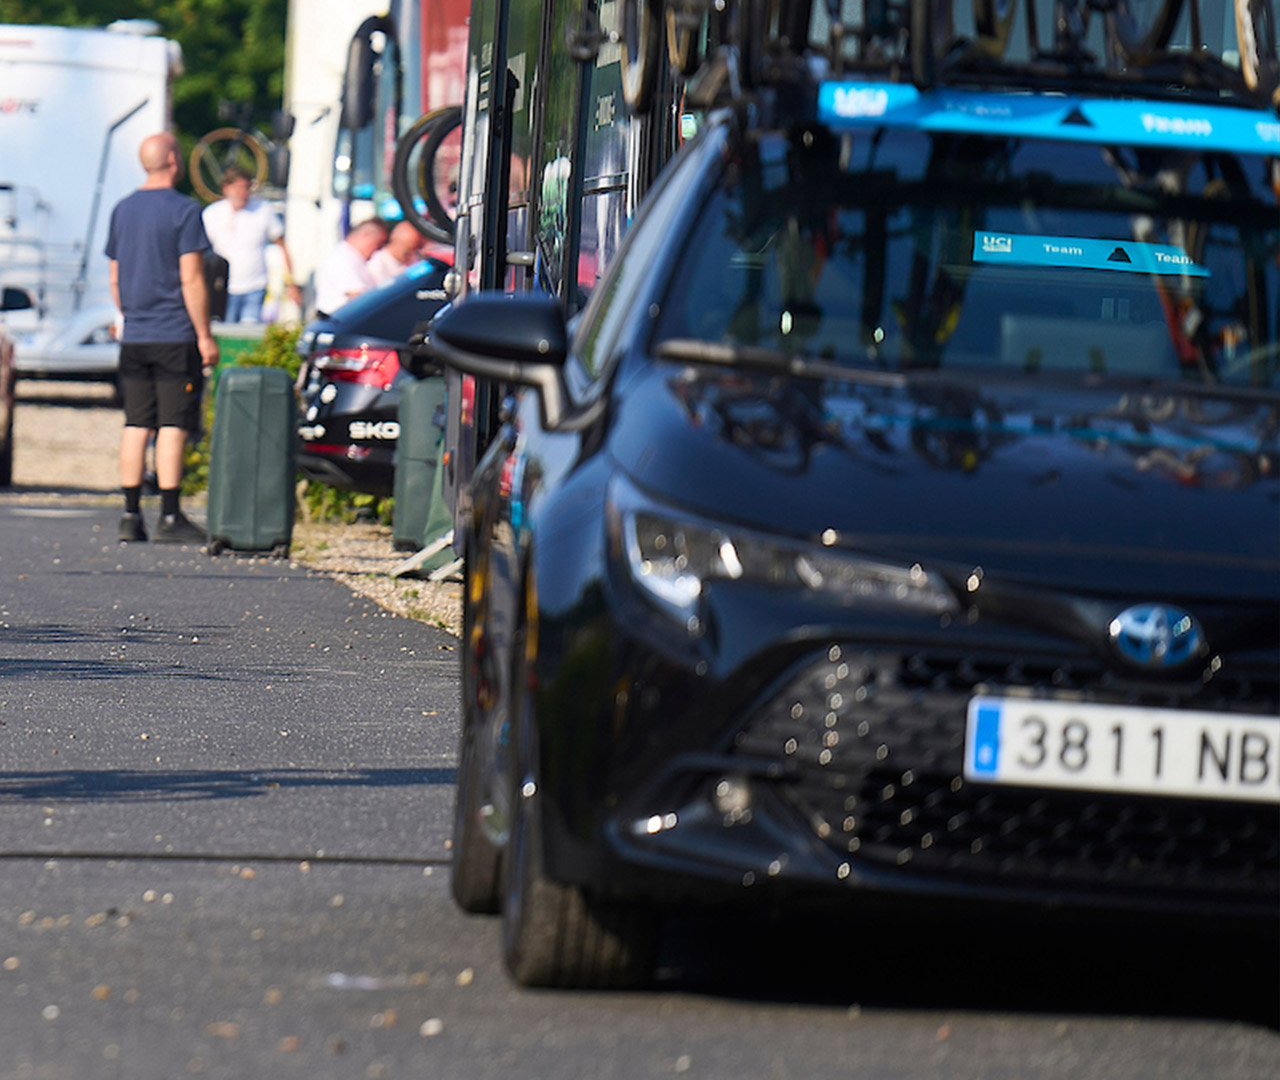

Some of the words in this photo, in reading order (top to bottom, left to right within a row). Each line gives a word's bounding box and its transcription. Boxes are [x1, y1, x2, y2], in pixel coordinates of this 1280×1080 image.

[1043, 243, 1082, 255] Team
[1017, 715, 1166, 779] 3811
[1197, 728, 1280, 786] NB
